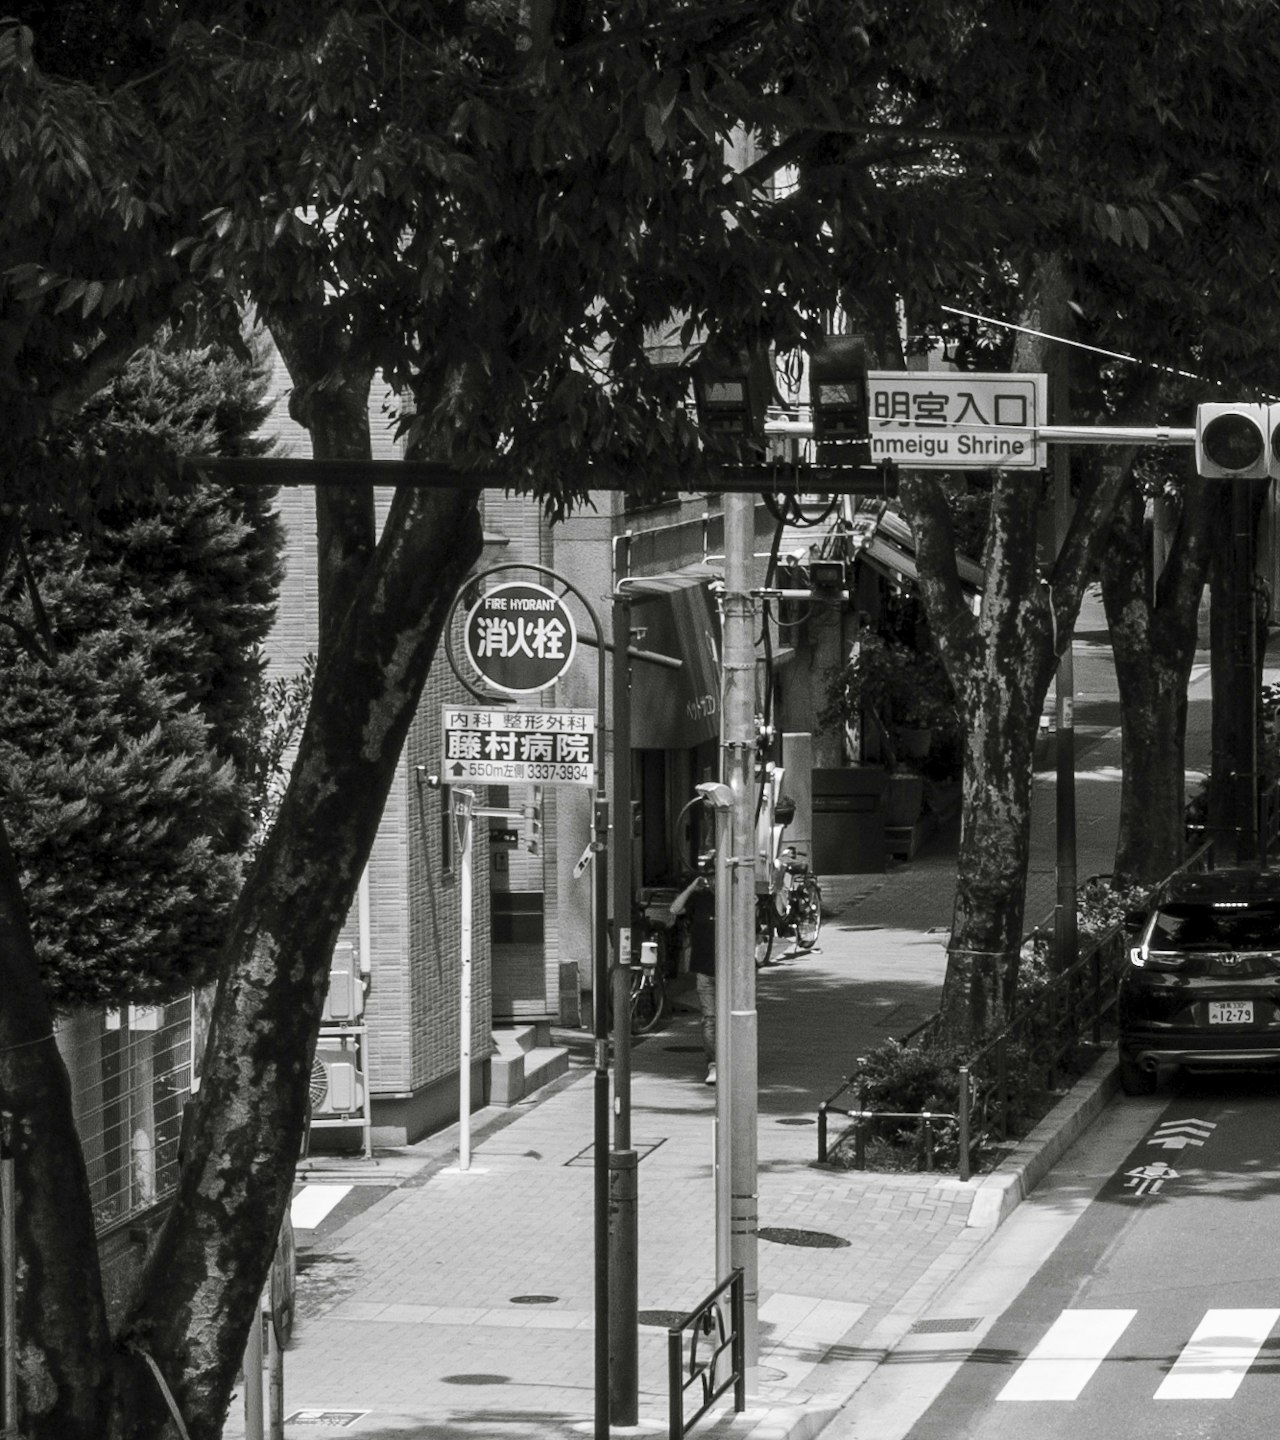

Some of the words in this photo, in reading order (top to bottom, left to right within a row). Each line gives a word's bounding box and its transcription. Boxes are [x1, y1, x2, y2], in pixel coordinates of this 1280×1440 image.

[957, 434, 1024, 455] Shrine
[484, 598, 508, 610] FIRE
[509, 598, 556, 611] HYDRANT
[476, 616, 566, 659] 消火栓
[450, 712, 492, 728] 内科
[503, 714, 587, 731] 整形外科
[447, 731, 590, 763] 藤村病院
[469, 763, 525, 779] 550m左側
[527, 764, 588, 780] 3337-3934
